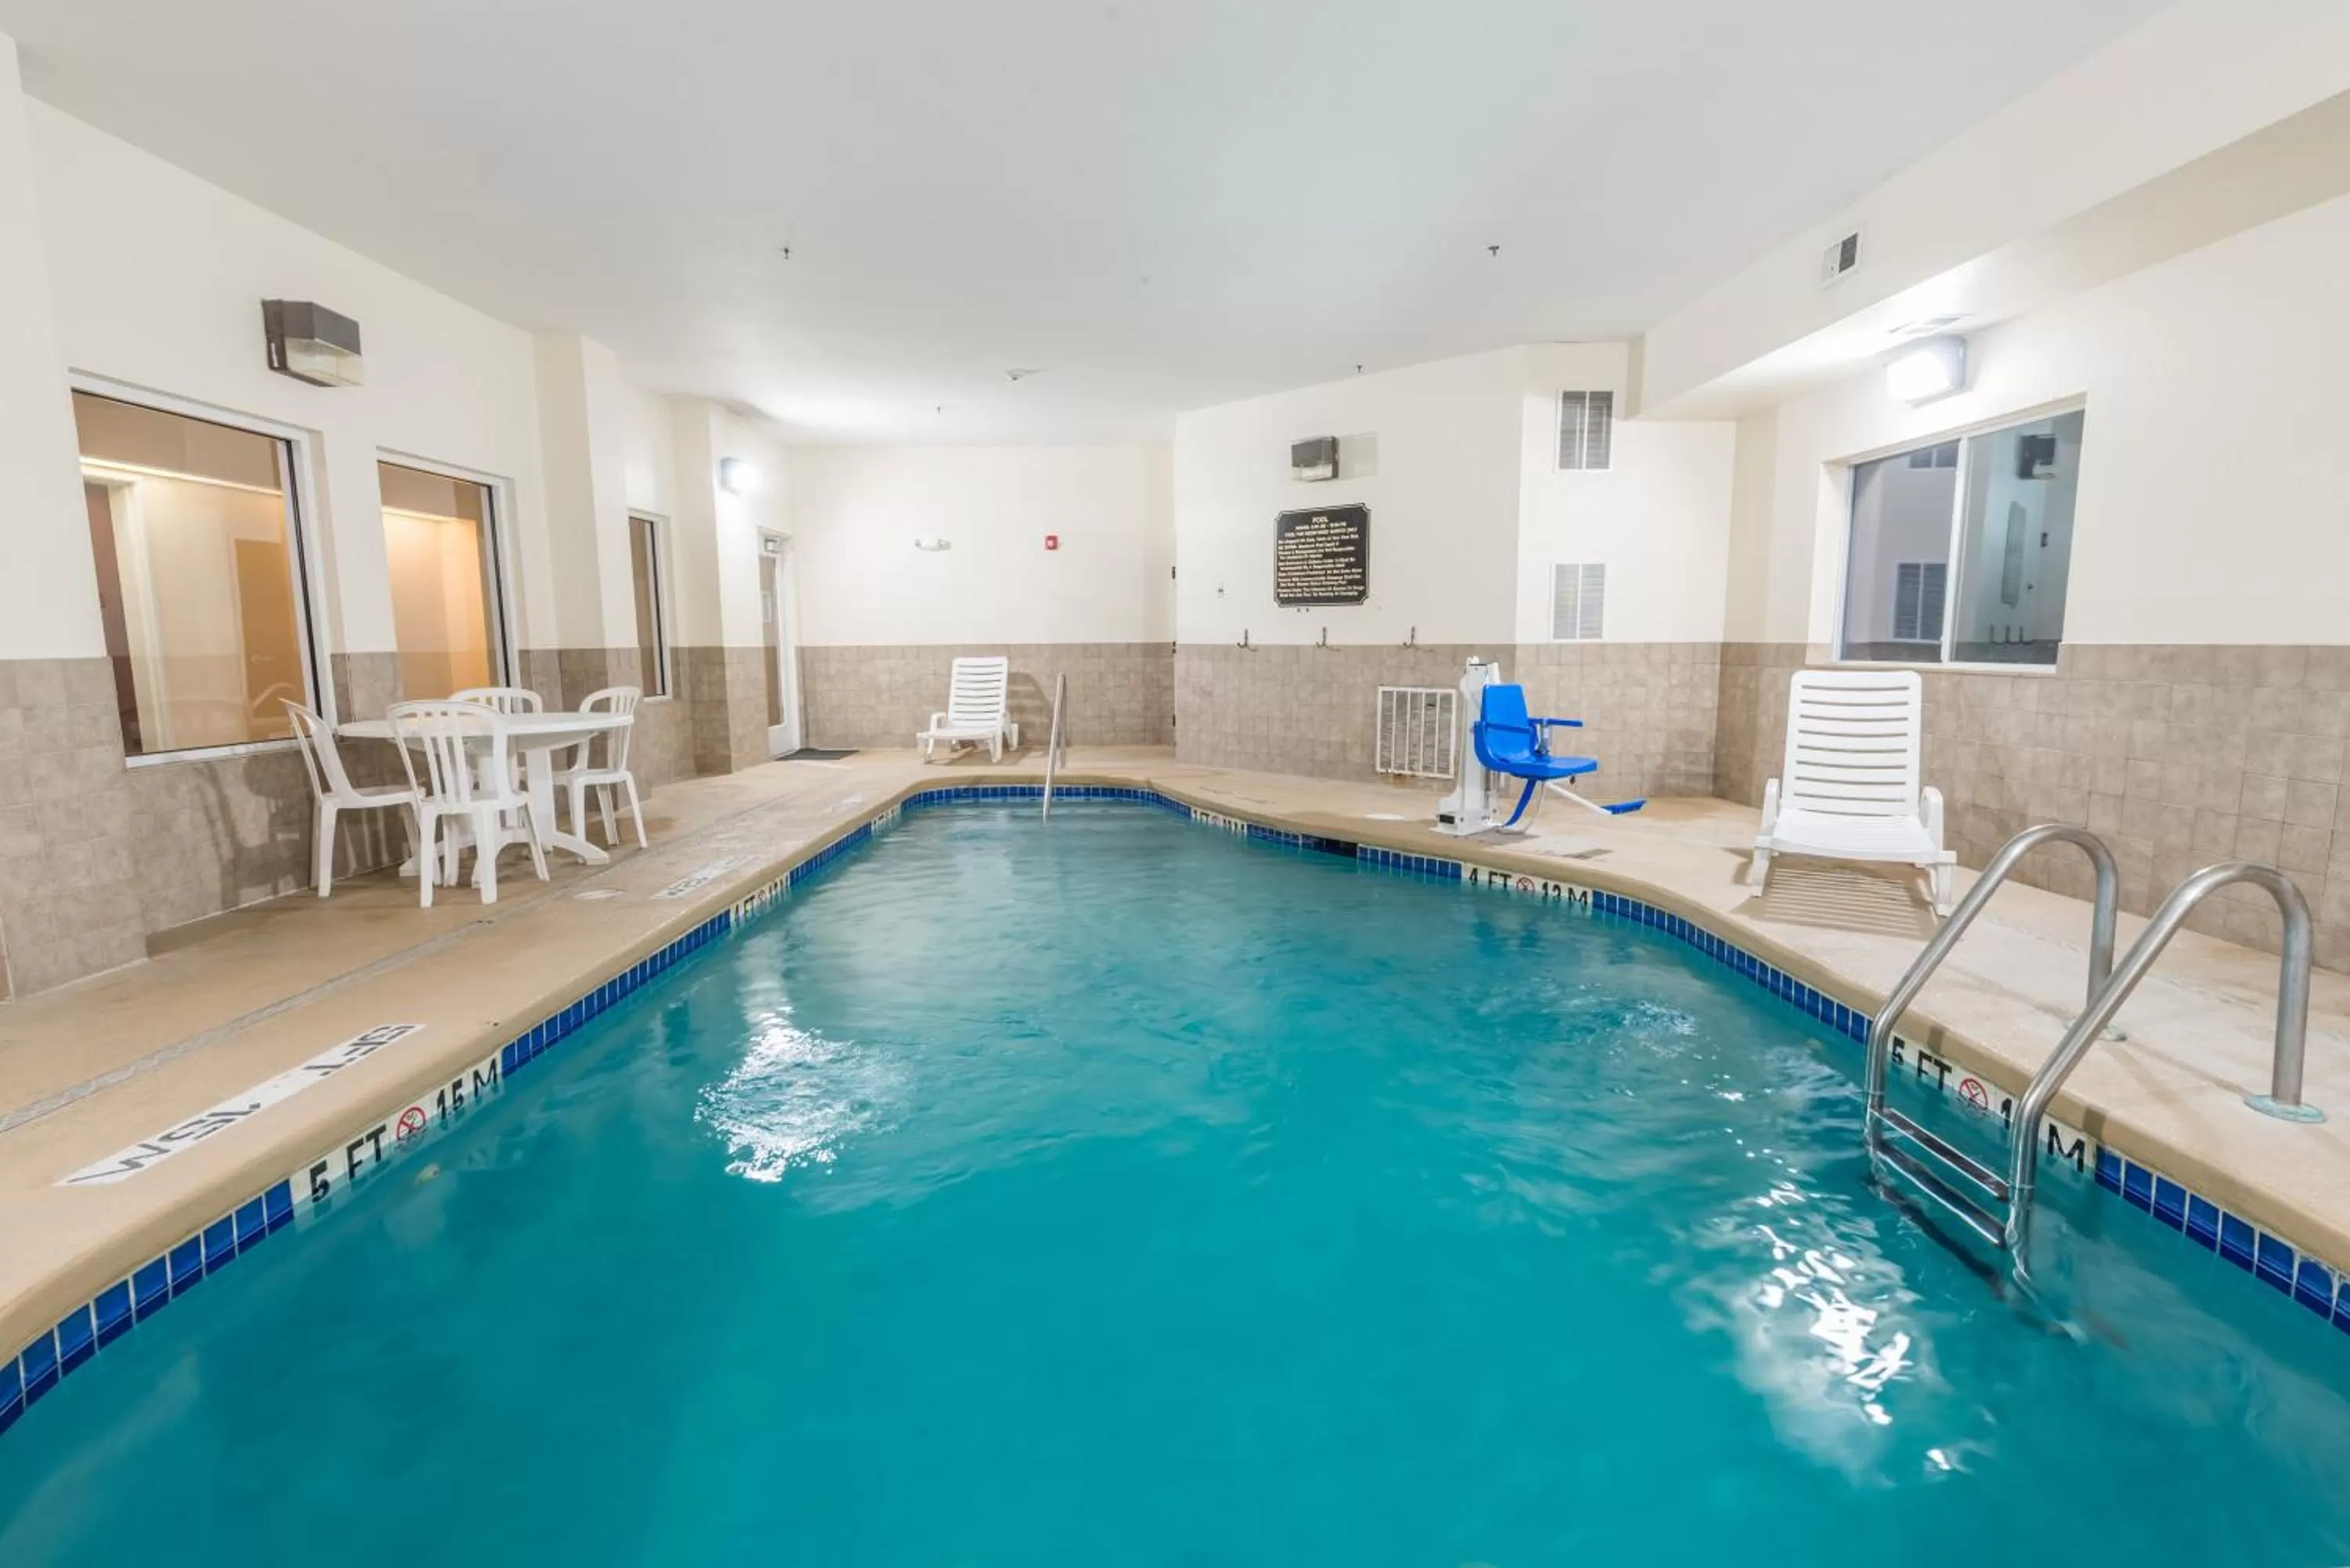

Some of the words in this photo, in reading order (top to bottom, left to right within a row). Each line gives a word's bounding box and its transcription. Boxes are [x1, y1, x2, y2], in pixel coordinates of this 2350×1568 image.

[309, 1160, 330, 1202] 5
[346, 1124, 386, 1180] FT
[473, 1058, 497, 1098] M
[1892, 1036, 1905, 1066] 5
[1918, 1049, 1953, 1091] FT
[2047, 1122, 2085, 1174] M
